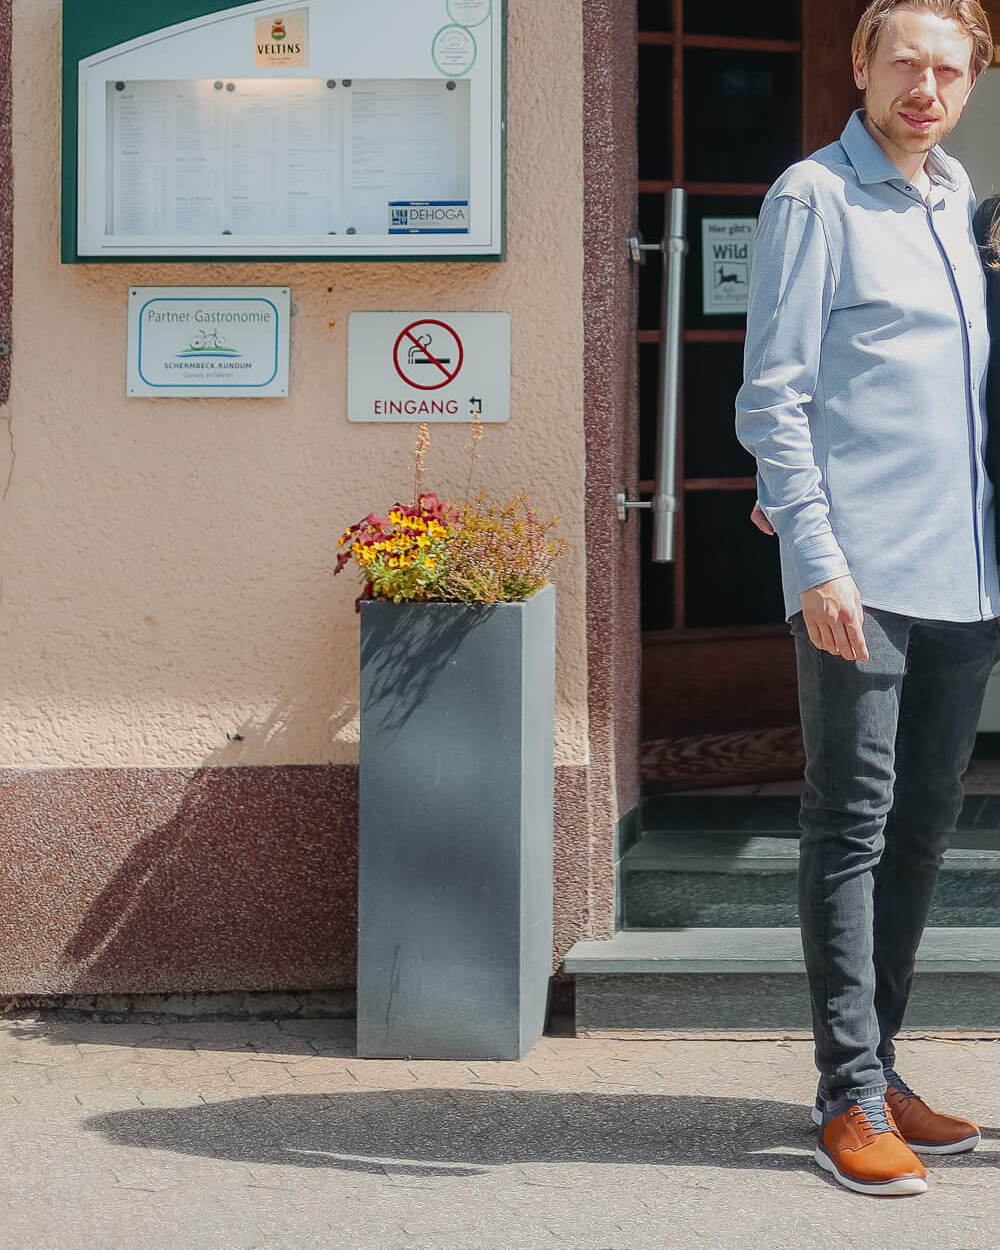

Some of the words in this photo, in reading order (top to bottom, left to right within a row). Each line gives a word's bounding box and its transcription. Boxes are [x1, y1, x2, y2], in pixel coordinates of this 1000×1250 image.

[257, 44, 301, 54] VELTINS
[409, 208, 465, 221] DEHOGA
[712, 243, 748, 259] Wild
[147, 309, 271, 323] Partner-Gastronomie
[374, 399, 459, 415] EINGANG
